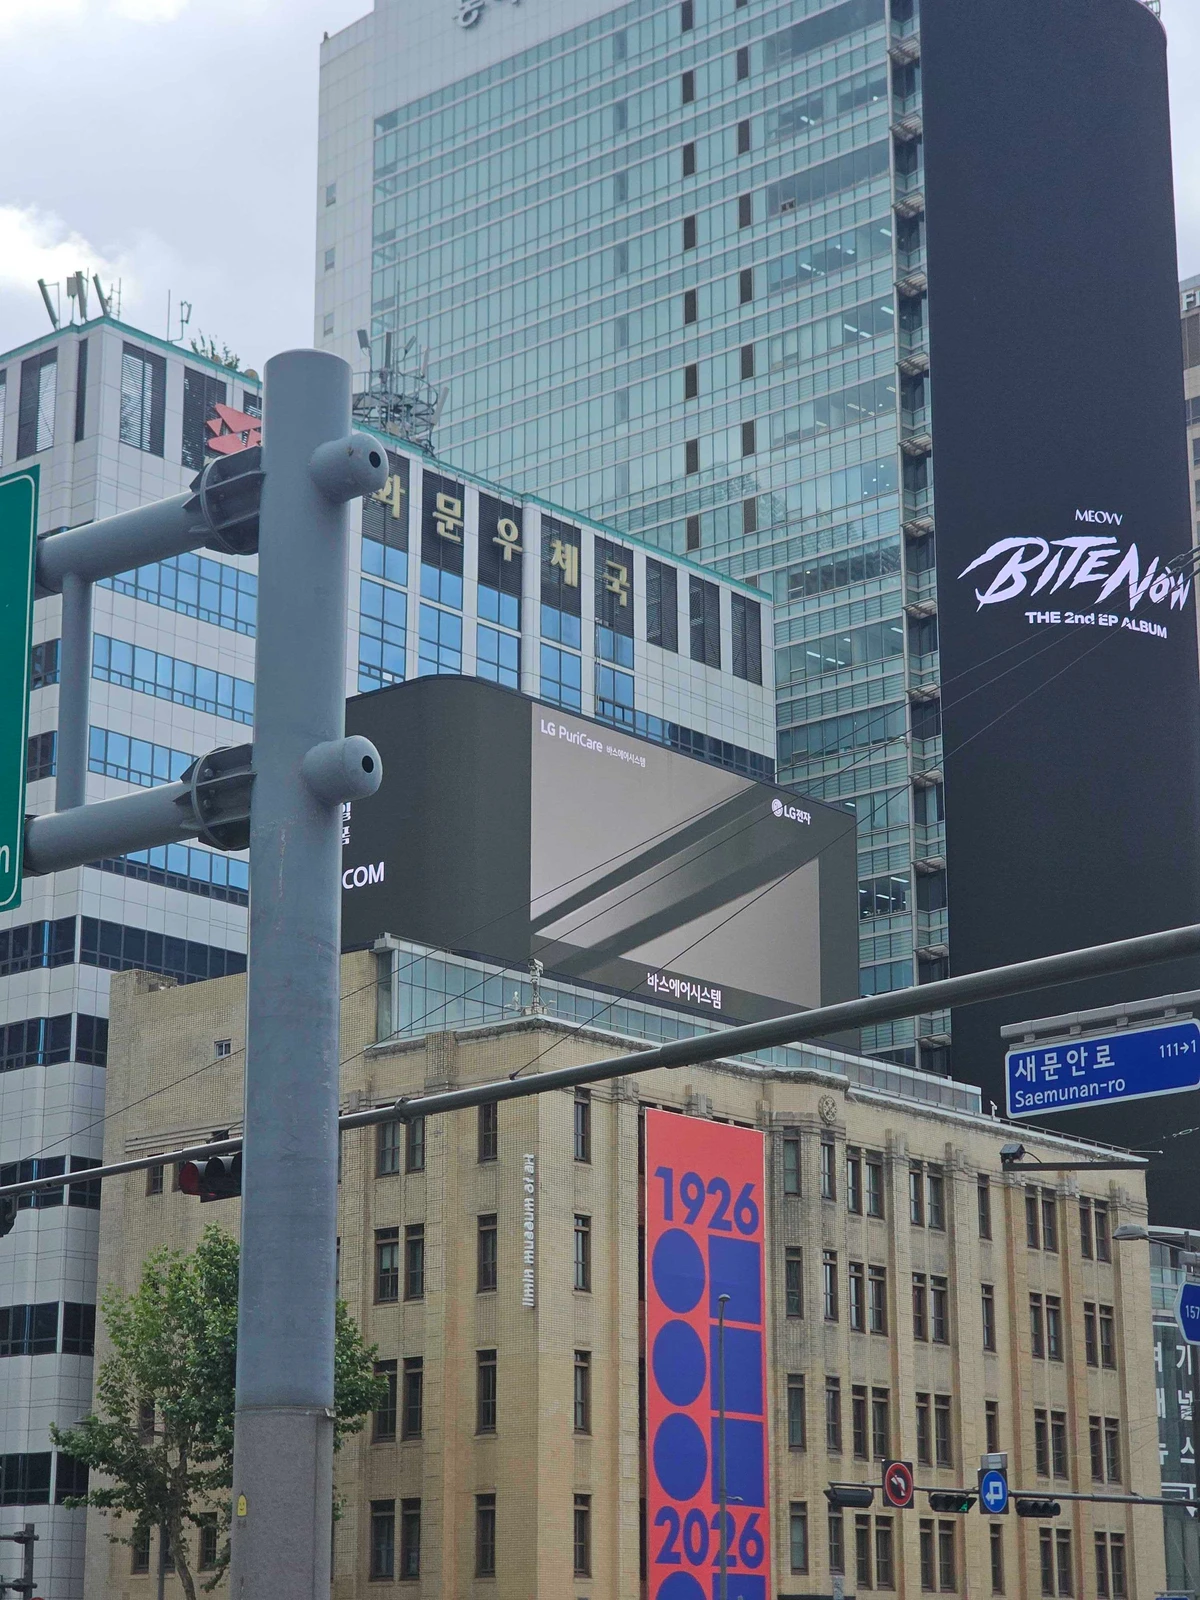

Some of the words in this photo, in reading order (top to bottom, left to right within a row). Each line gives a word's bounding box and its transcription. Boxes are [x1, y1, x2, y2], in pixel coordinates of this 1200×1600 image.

[957, 536, 1121, 612] BITE
[1025, 611, 1061, 625] THE
[1064, 611, 1095, 626] 2nd
[1098, 613, 1119, 627] EP
[1121, 618, 1167, 640] ALBUM
[540, 719, 556, 737] LG
[558, 725, 603, 753] PuriCare
[647, 972, 722, 1010] 바스에어시스템
[1014, 1044, 1116, 1083] 새문안로
[1014, 1078, 1126, 1108] Saemunan-ro
[654, 1165, 760, 1236] 1926
[654, 1505, 765, 1569] 2026
